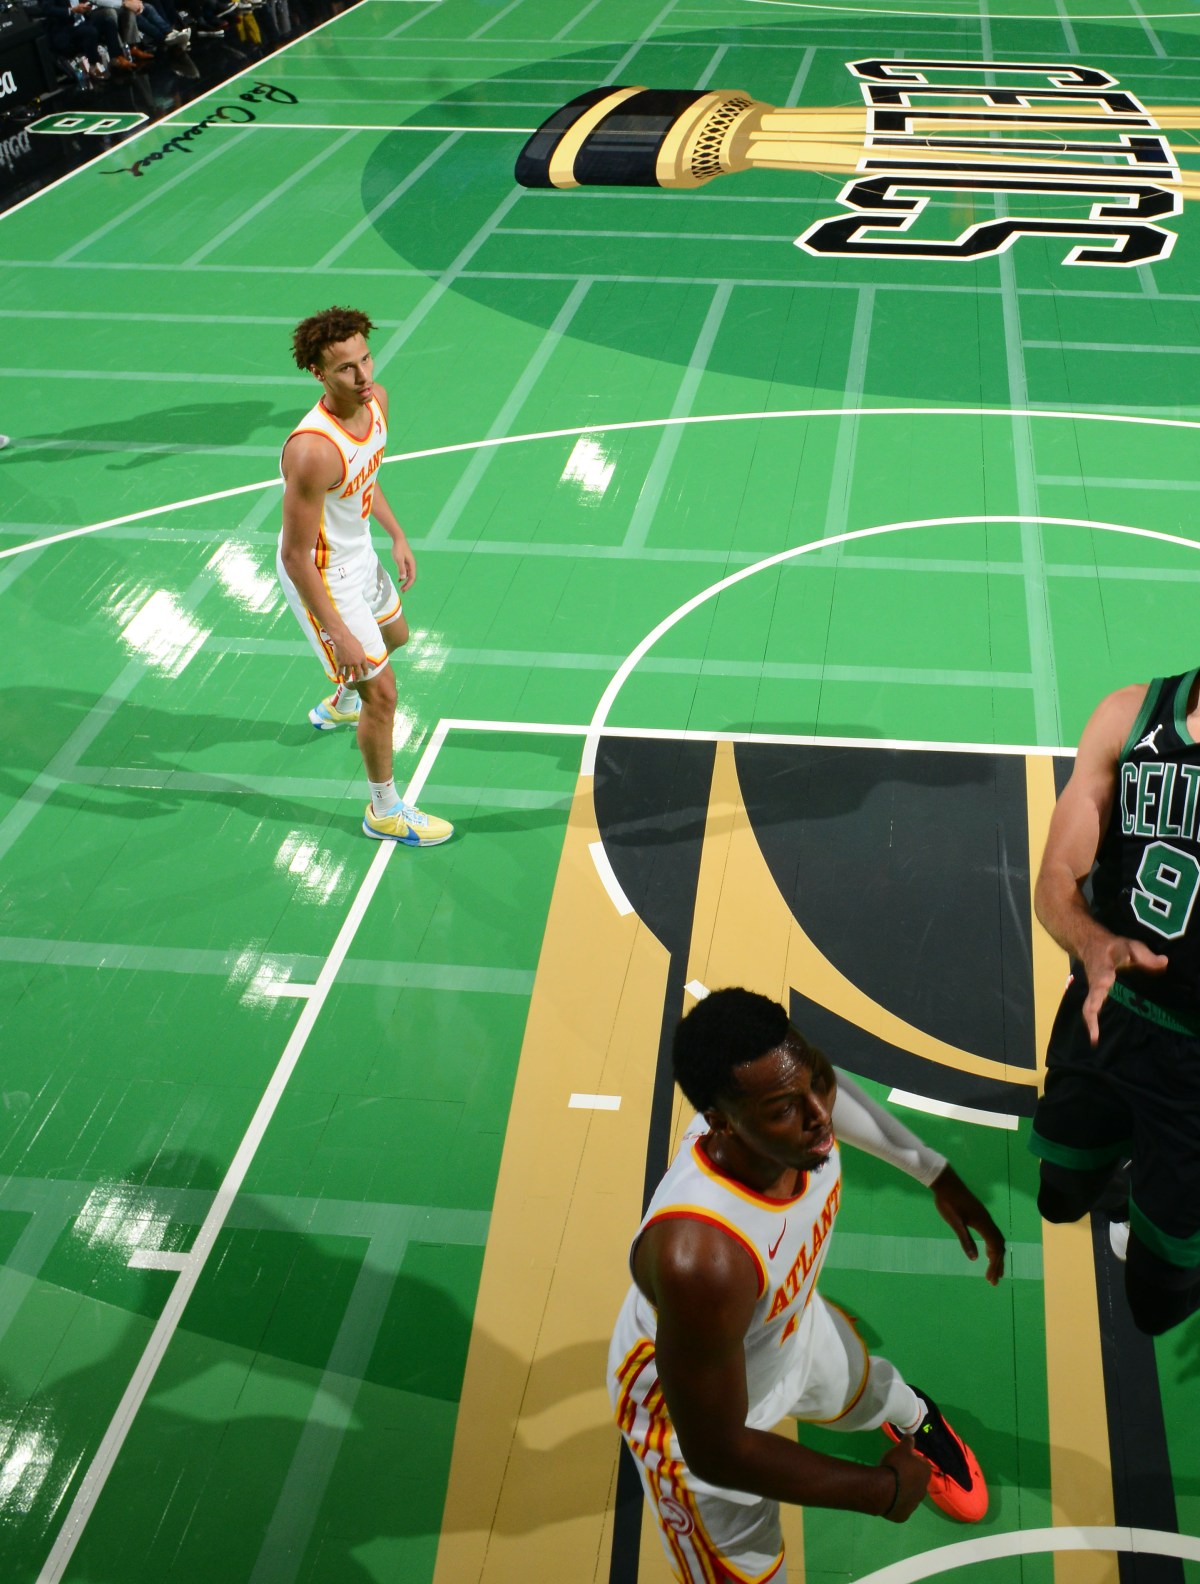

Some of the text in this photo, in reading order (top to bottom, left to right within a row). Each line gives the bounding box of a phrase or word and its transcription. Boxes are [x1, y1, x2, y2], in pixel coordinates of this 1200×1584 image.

[793, 58, 1184, 268] CELTICS
[339, 445, 386, 500] ATLANT
[361, 480, 376, 520] 5
[764, 1179, 842, 1326] ATLANT
